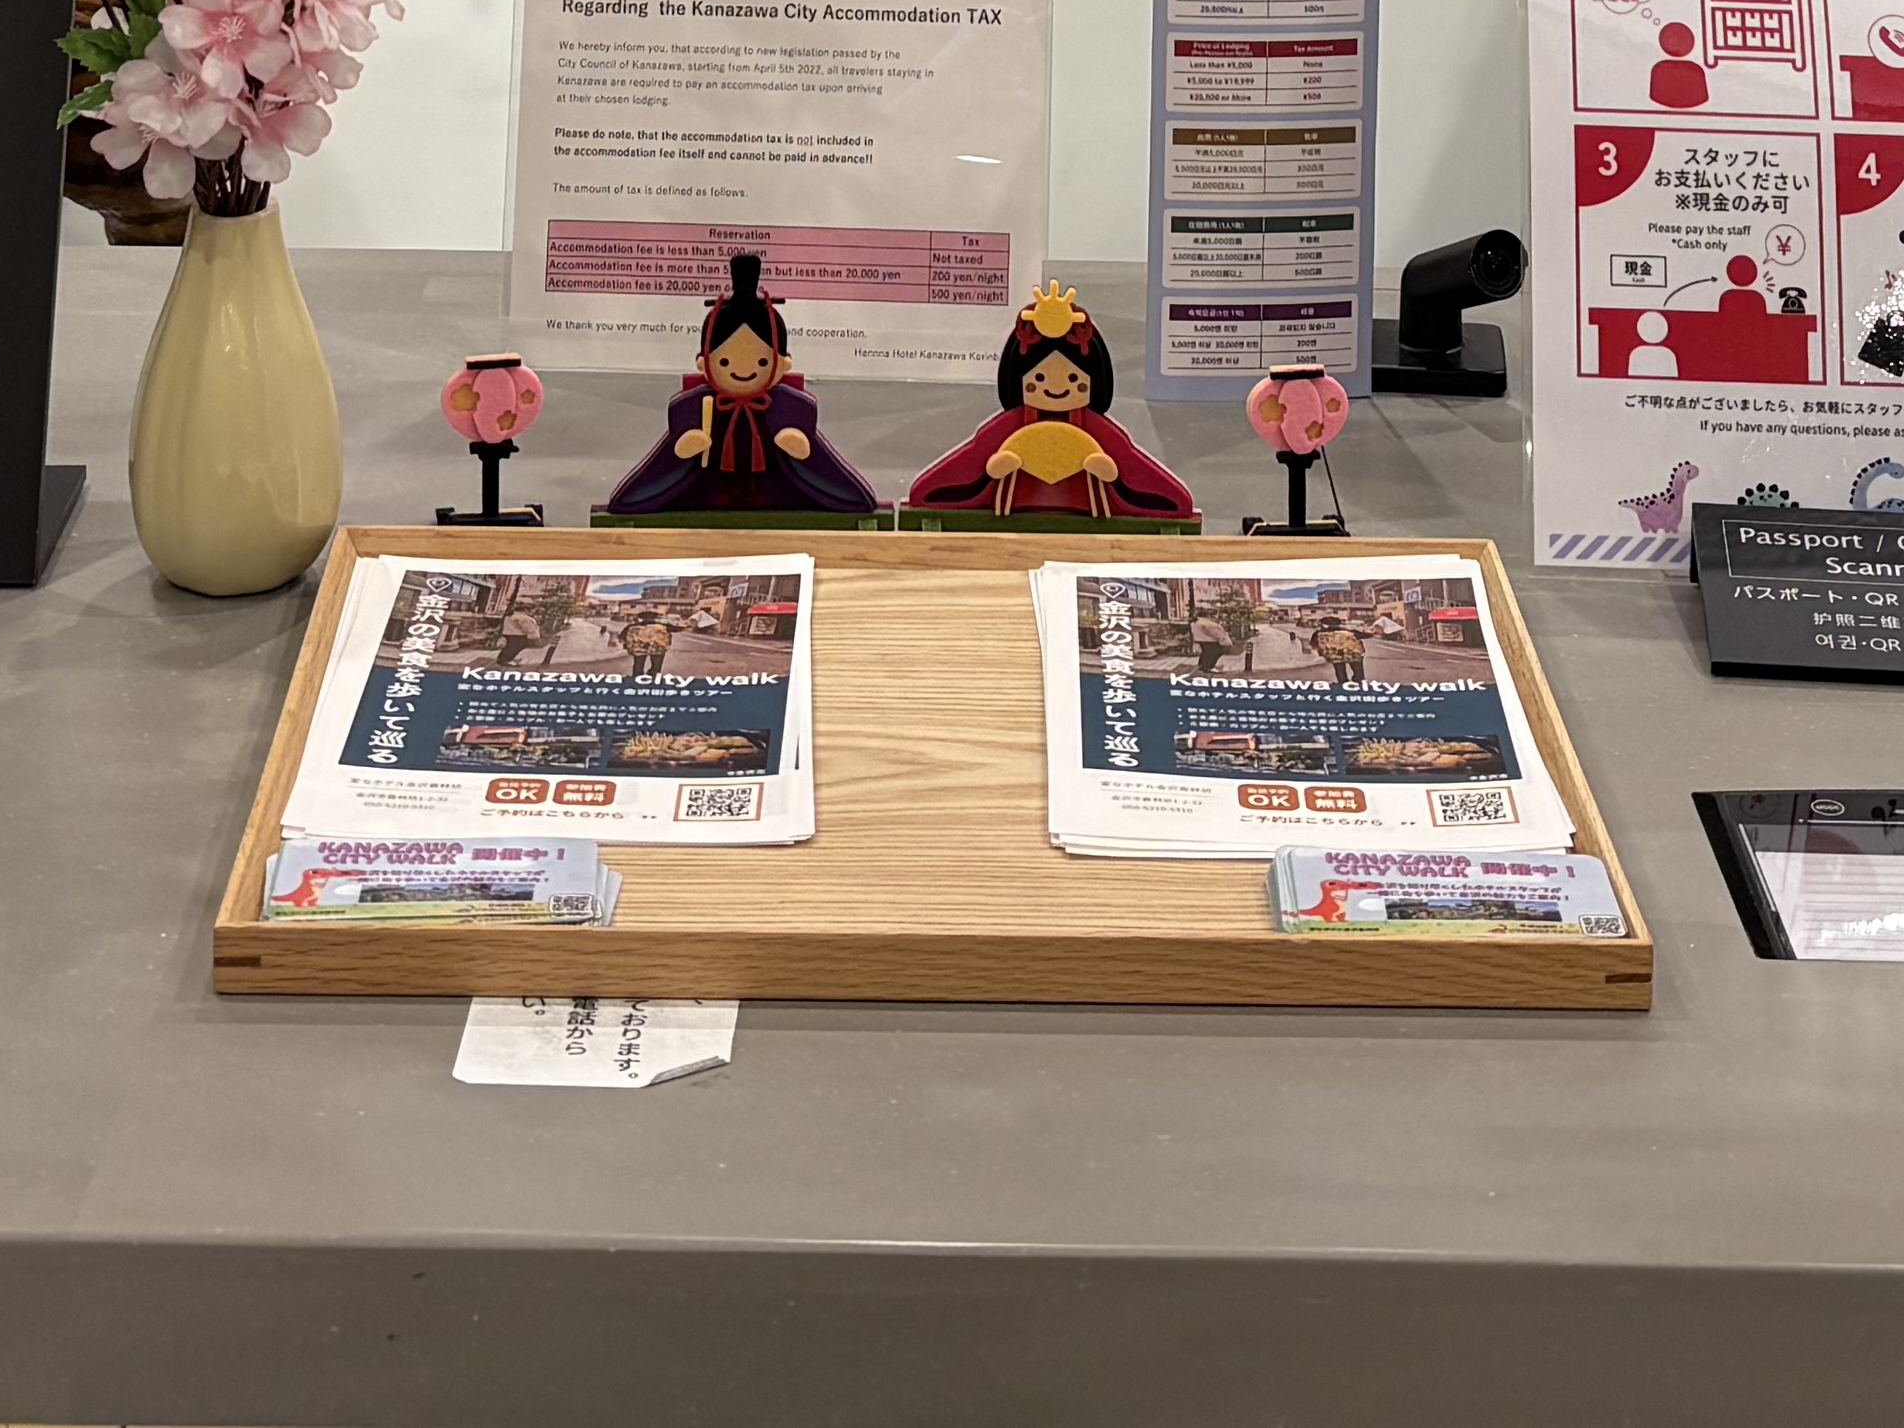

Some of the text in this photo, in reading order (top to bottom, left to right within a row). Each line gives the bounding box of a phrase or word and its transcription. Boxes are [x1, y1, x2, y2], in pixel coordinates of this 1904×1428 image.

[658, 0, 686, 15] the
[692, 0, 778, 18] Kanazawa
[784, 2, 817, 22] City
[822, 3, 960, 23] Accommodation
[966, 8, 1001, 25] TAX
[1598, 141, 1618, 176] 3
[1683, 147, 1779, 167] スタッフに
[1858, 152, 1880, 186] 4
[1654, 168, 1809, 191] お支払いください
[708, 227, 770, 240] Reservation
[1648, 222, 1751, 236] Please pay the staff
[961, 235, 979, 246] Tax
[1704, 239, 1727, 252] only
[932, 252, 983, 264] Not taxed
[1624, 260, 1652, 276] 現金
[931, 270, 1004, 284] 200 yen/night
[1700, 419, 1708, 430] If
[1710, 422, 1732, 433] you
[1735, 420, 1763, 432] have
[1765, 424, 1787, 436] any
[1789, 422, 1850, 437] questions,
[1852, 424, 1890, 438] please
[1739, 527, 1863, 550] Passport
[1876, 534, 1883, 552] /
[1734, 584, 1899, 606] パスポート・QR
[1814, 633, 1901, 652] 여권·QR
[367, 593, 442, 764] 金沢の美食を歩いて巡る
[462, 666, 780, 687] Kanazawa city walk
[1098, 600, 1140, 768] 金沢の美食を歩いて巡る
[1169, 673, 1486, 694] Kanazawa city walk
[496, 788, 541, 802] OK
[563, 792, 605, 804] 無料
[1246, 794, 1290, 808] OK
[1240, 814, 1383, 827] ご予約はこちらから
[318, 841, 463, 856] KANAZAWA
[322, 852, 457, 865] CITY WALK
